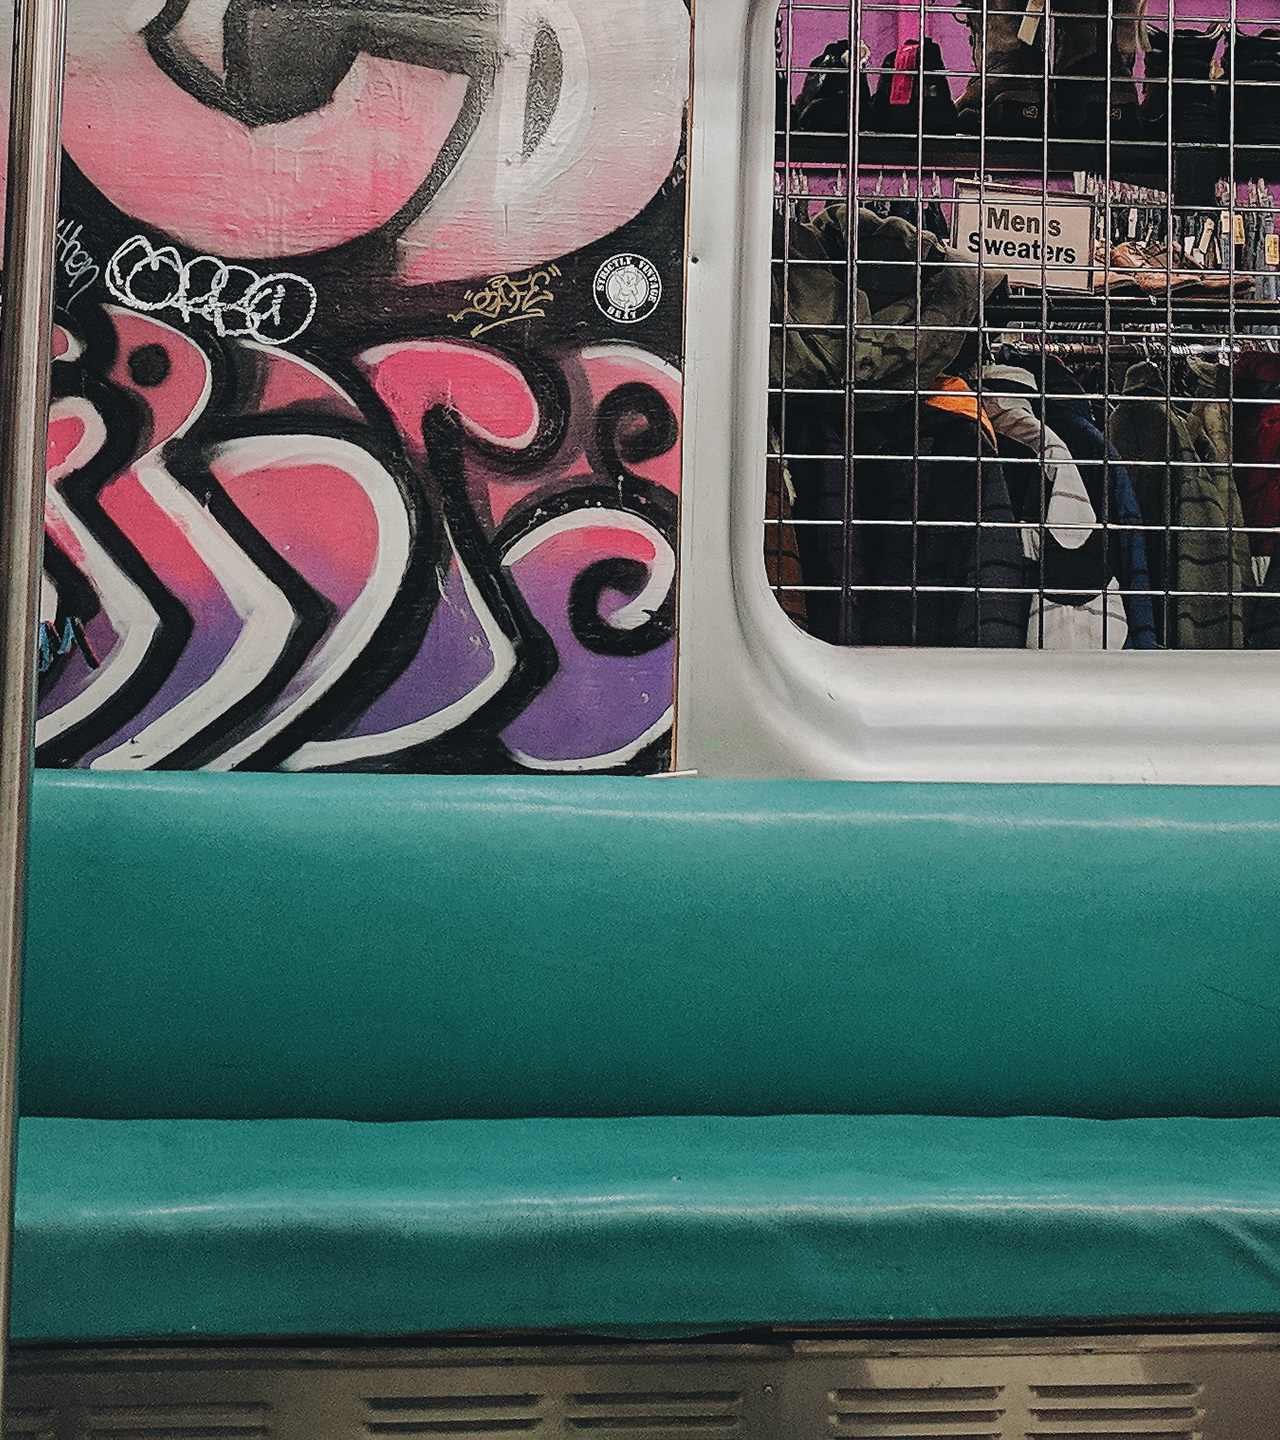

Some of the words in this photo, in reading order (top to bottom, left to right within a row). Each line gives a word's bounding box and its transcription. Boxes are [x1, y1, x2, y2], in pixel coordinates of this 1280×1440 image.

[967, 231, 1077, 264] Sweaters
[596, 256, 633, 292] STRICTLY
[638, 260, 659, 303] VINTAGE
